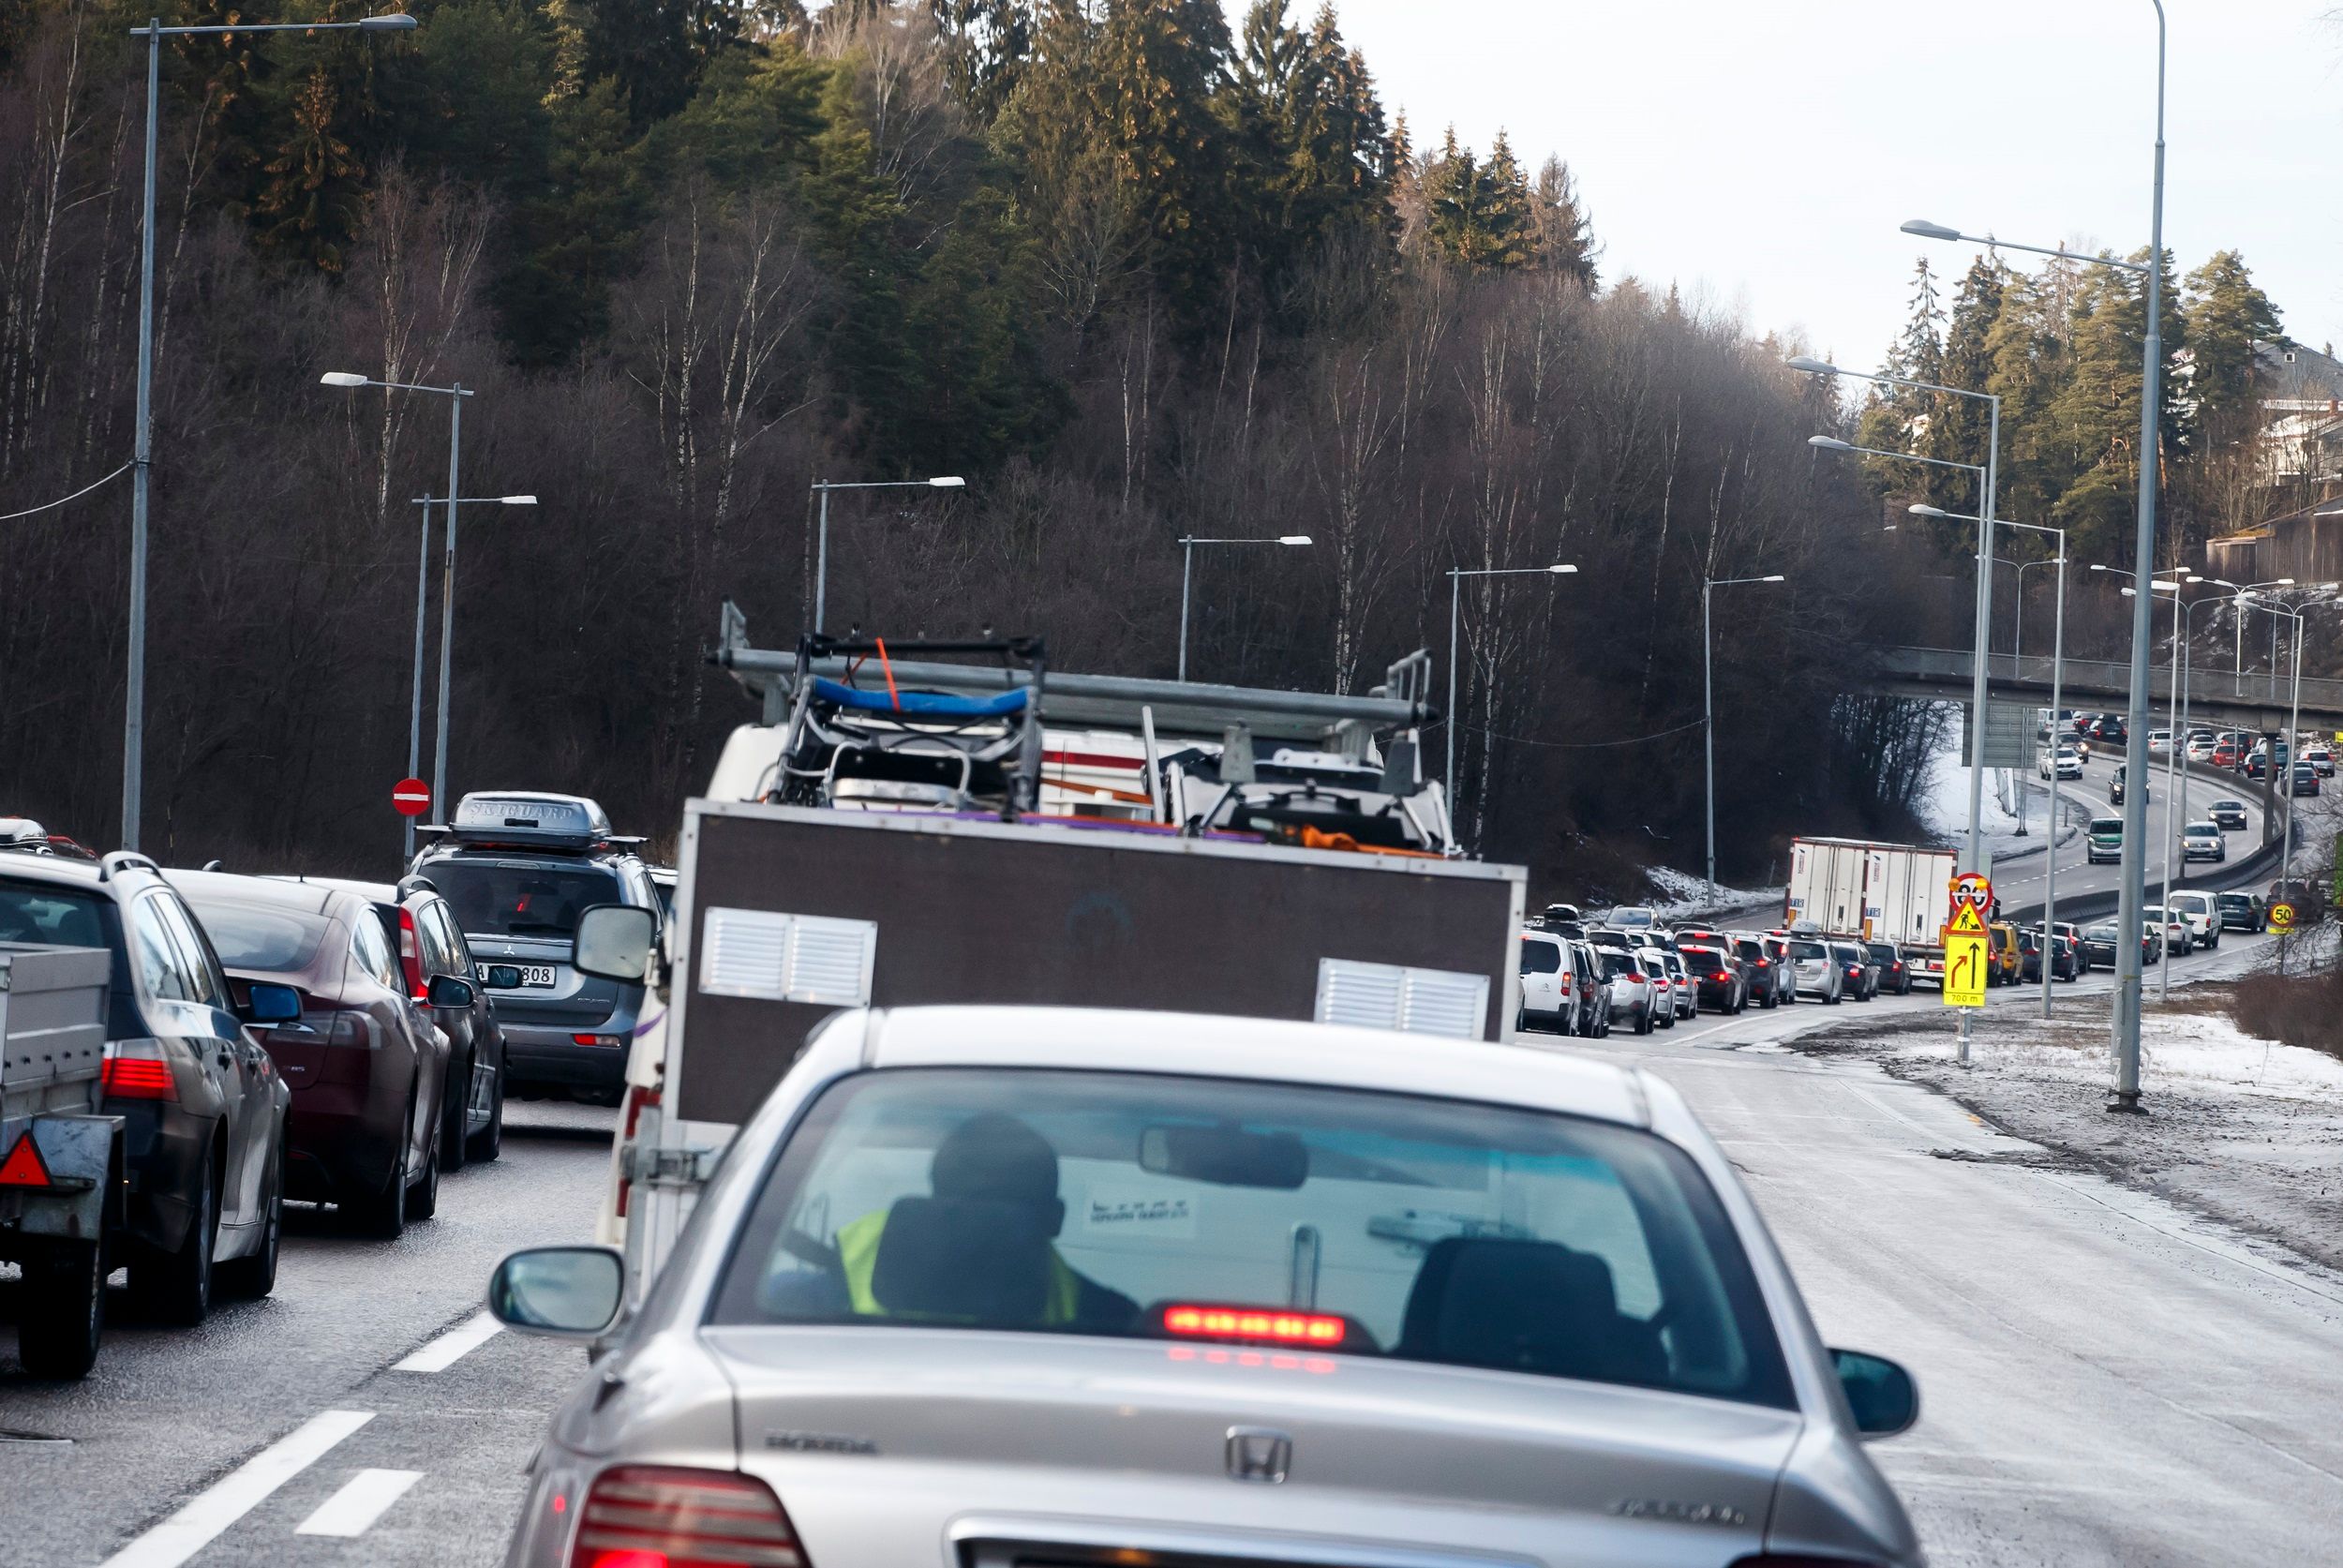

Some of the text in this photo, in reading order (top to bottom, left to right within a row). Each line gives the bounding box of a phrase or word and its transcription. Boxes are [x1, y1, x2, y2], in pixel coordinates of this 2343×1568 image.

[470, 803, 574, 820] SKIGUARD
[1866, 908, 1880, 917] TIR
[2276, 909, 2291, 920] 50
